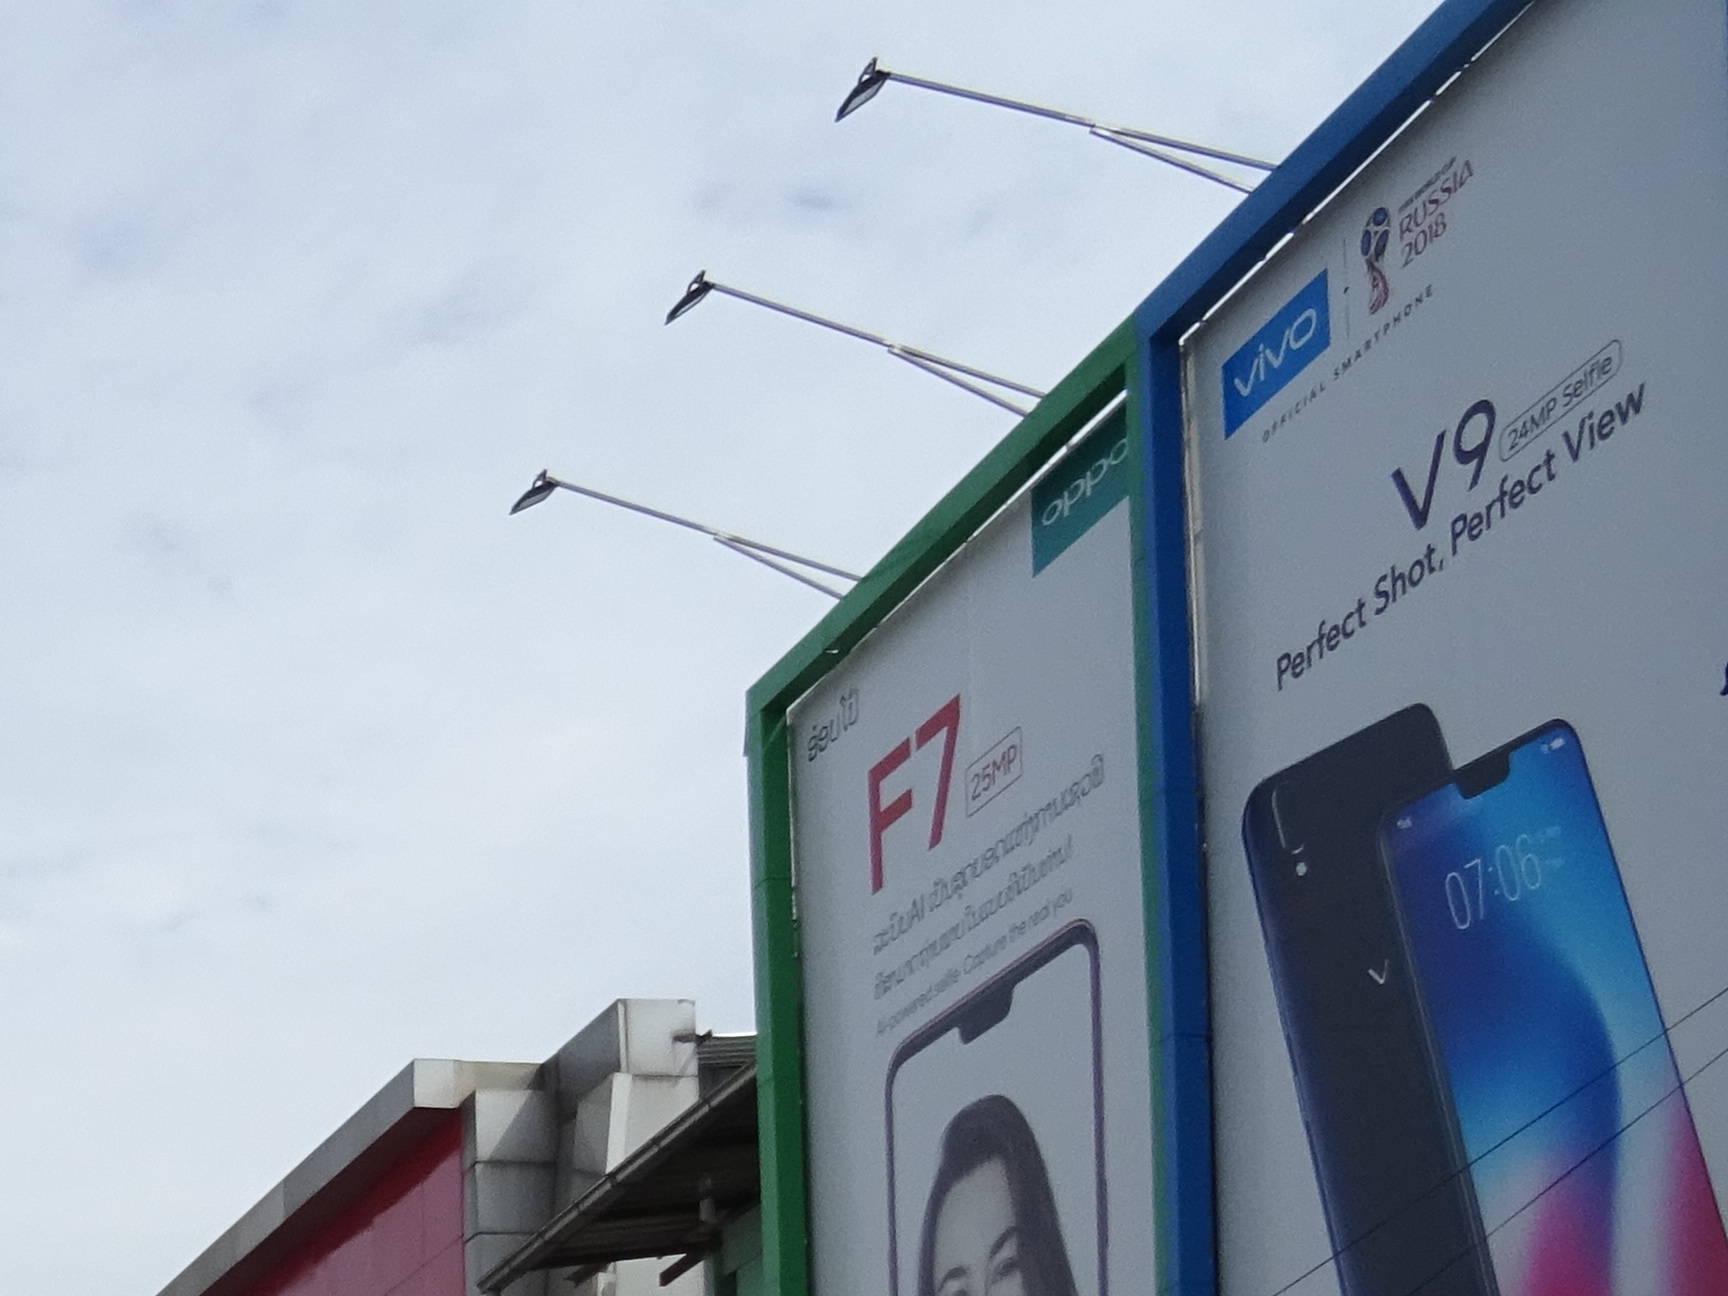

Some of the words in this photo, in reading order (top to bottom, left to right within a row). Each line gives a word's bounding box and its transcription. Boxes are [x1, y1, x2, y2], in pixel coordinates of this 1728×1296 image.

[1399, 160, 1474, 241] RUSSIA
[1403, 214, 1447, 268] 2018
[1234, 308, 1317, 397] vivo
[1262, 382, 1326, 443] OFFICIAL
[1334, 284, 1433, 381] SMARTPHONE
[1507, 400, 1556, 451] 24MP
[1562, 356, 1613, 407] Selfie
[1391, 400, 1495, 530] V9
[1277, 599, 1366, 691] Perfect
[1374, 544, 1444, 616] Shot,
[1451, 450, 1555, 555] Perfect
[1563, 382, 1645, 463] View
[868, 693, 961, 895] F7
[971, 744, 1017, 801] 25MP
